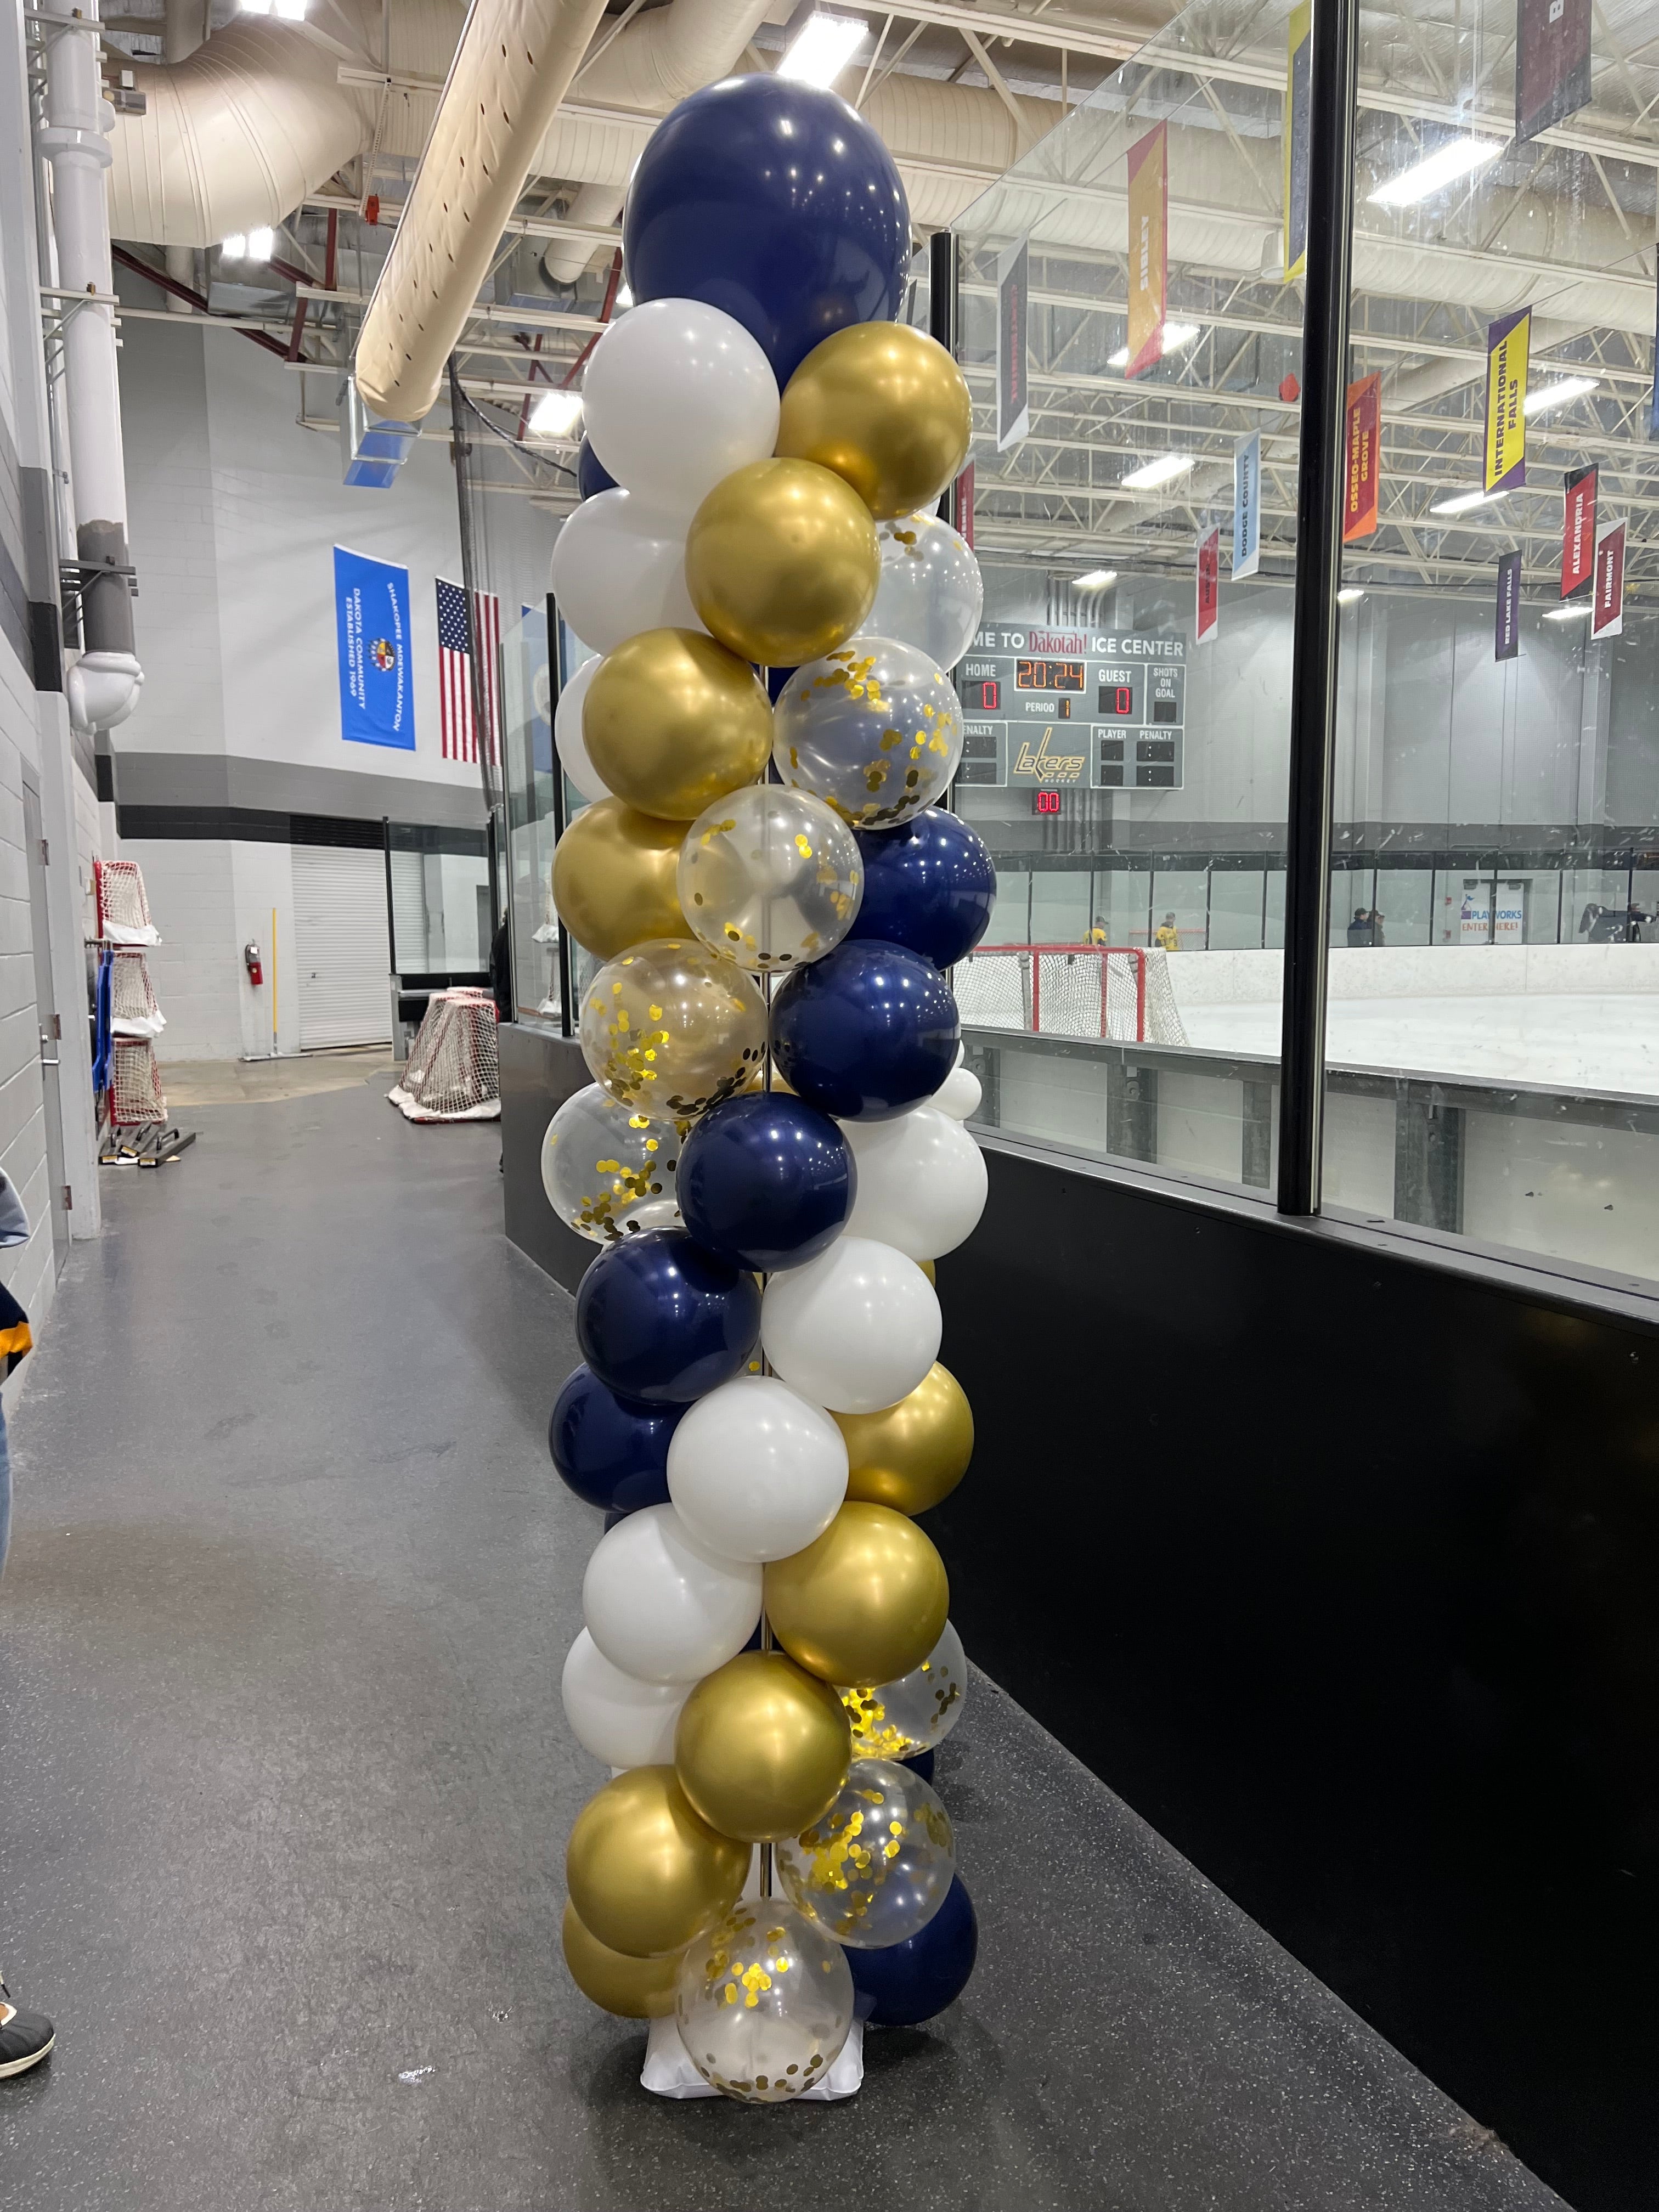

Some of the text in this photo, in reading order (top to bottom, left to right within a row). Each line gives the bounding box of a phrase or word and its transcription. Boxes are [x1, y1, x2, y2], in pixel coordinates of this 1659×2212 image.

[1140, 216, 1149, 291] SIBLEY
[1495, 340, 1507, 476] INTERNATIONAL
[1509, 379, 1518, 430] FALLS
[1350, 407, 1361, 512] OSSEO-MAPLE
[1573, 493, 1583, 574] ALEXANDRIA
[1604, 550, 1614, 608] FAIRMONT
[346, 596, 356, 668] ESTABLISHED
[973, 631, 996, 647] ME
[1001, 632, 1025, 649] TO
[1092, 636, 1117, 653] ICE
[1121, 639, 1183, 657] CENTER
[354, 588, 366, 709] DAKOTA COMMUNITY
[387, 582, 404, 731] SHAKOPEE MDEWAKANTON
[966, 663, 996, 677] HOME
[1018, 661, 1083, 689] 20:24
[1098, 669, 1132, 683] GUEST
[1153, 667, 1178, 678] SHOTS
[1160, 678, 1171, 687] ON
[983, 682, 997, 709] 0
[1116, 687, 1130, 714] 0
[1155, 688, 1176, 698] GOAL
[1025, 702, 1055, 713] PERIOD
[1065, 699, 1070, 718] 1
[963, 725, 994, 735] ENALTY
[1098, 729, 1172, 740] PLAYER PENALTY
[1038, 792, 1059, 812] 00
[1462, 922, 1488, 932] ENTER
